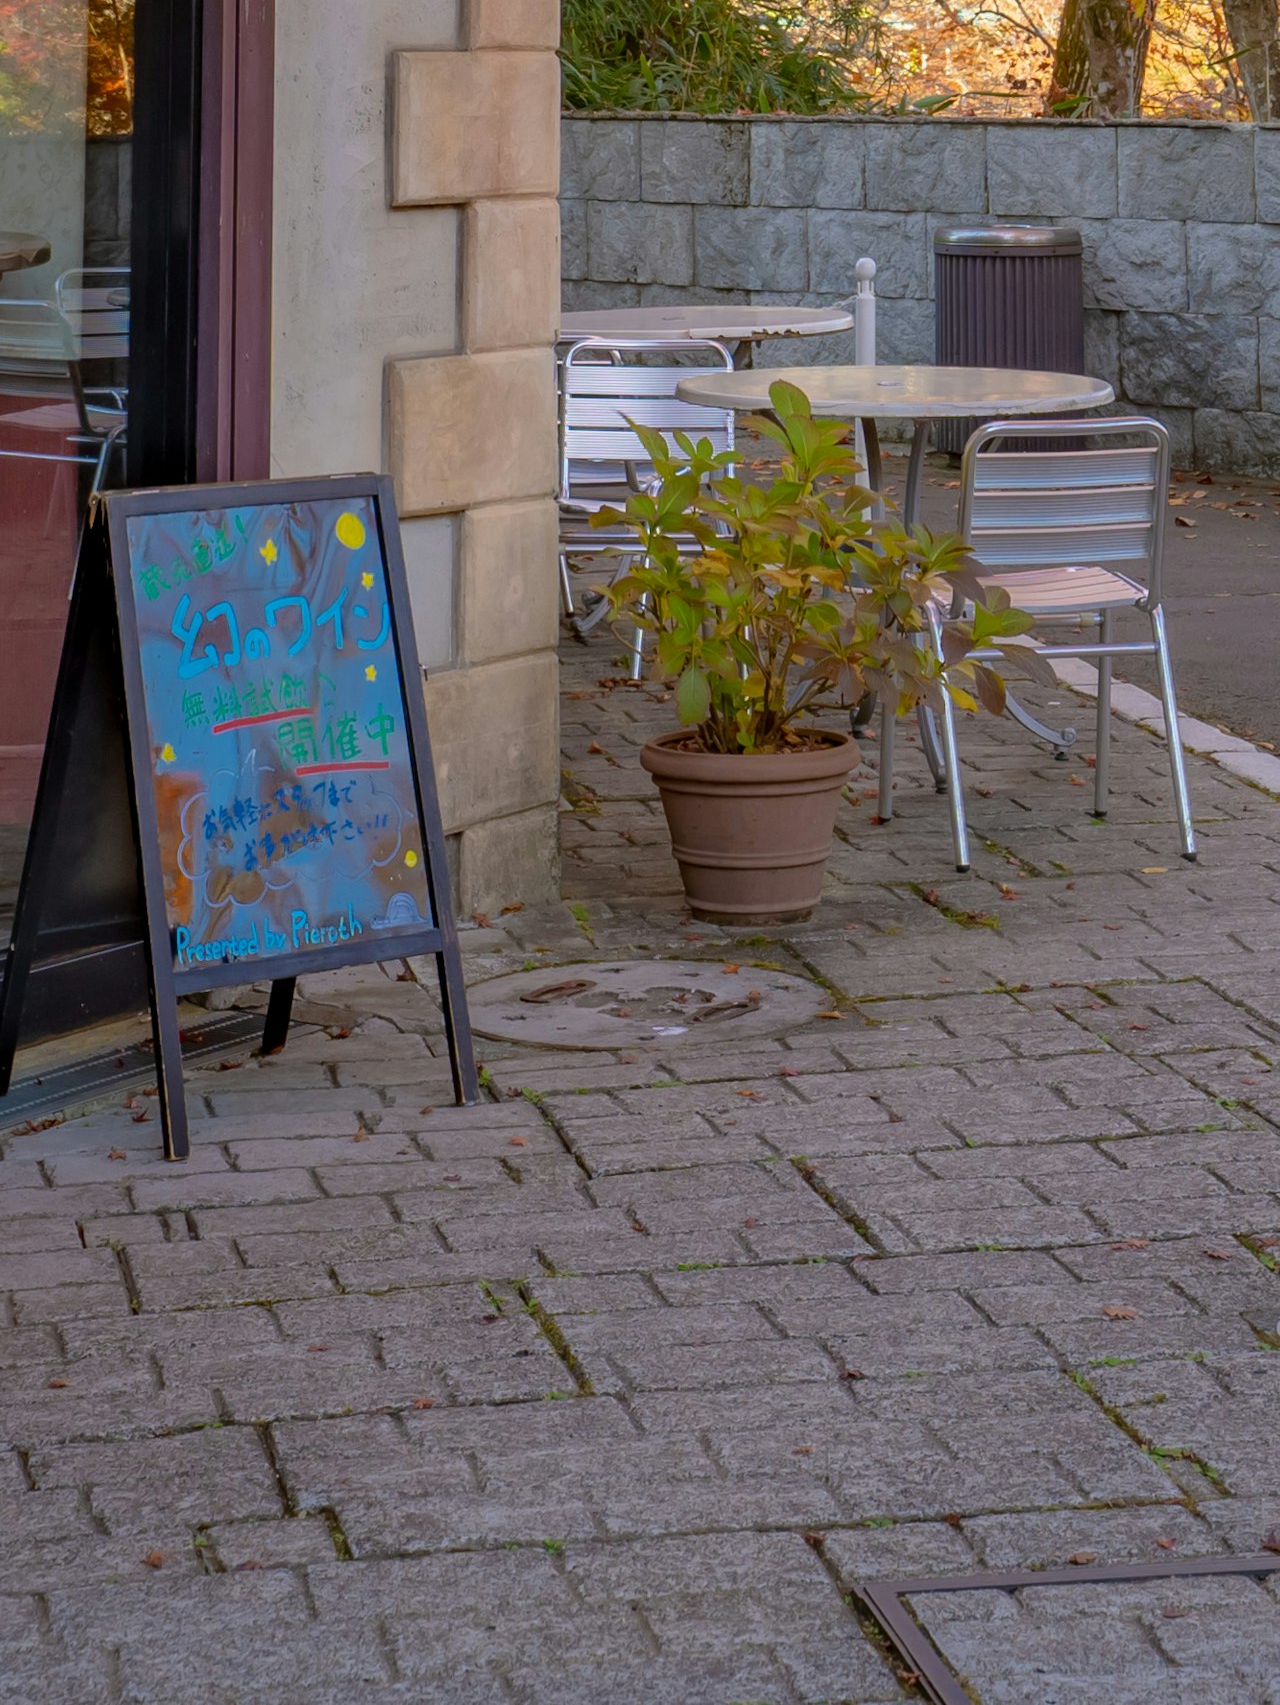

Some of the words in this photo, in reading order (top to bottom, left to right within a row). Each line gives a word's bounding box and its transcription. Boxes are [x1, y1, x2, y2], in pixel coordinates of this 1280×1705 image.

[171, 588, 391, 680] 幻のワイン
[276, 702, 396, 771] 開催中
[176, 920, 259, 966] Presented
[263, 917, 286, 951] by
[291, 901, 364, 949] Pieroth
